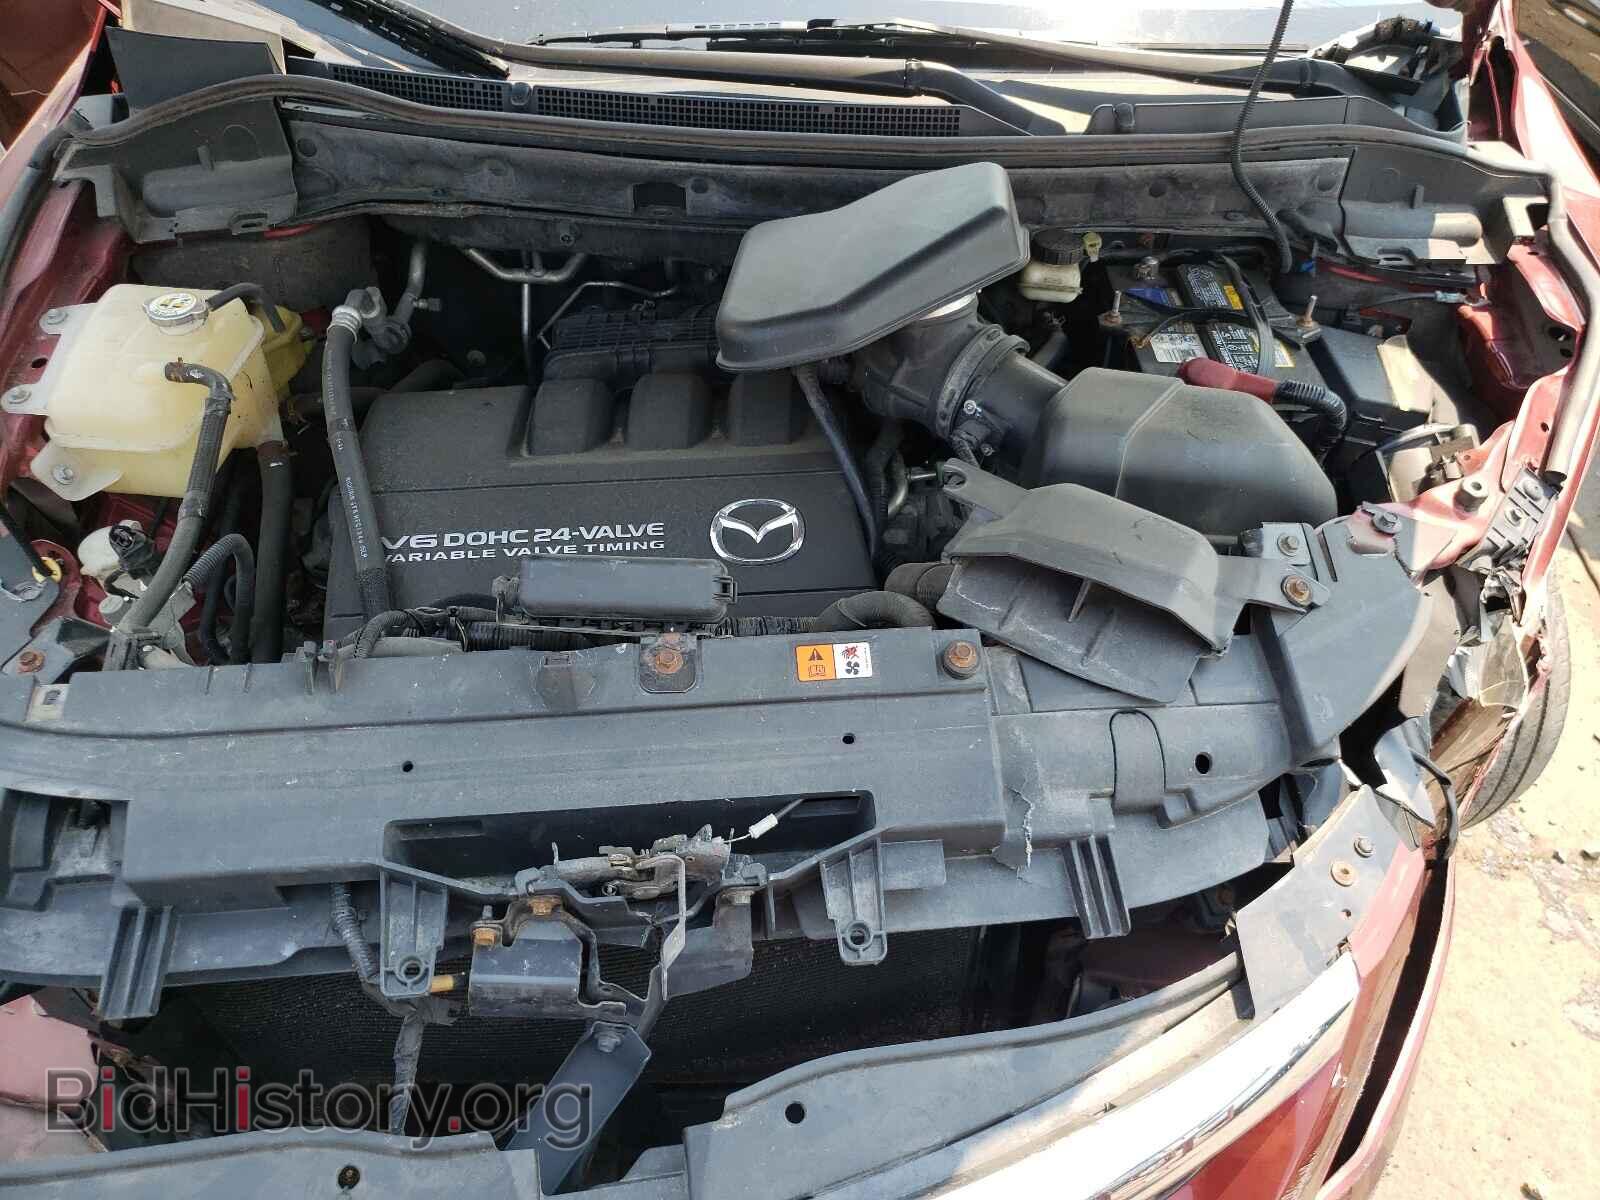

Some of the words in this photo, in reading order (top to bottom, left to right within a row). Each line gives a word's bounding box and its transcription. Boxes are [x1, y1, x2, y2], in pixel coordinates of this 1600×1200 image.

[381, 533, 438, 550] V6
[443, 529, 529, 547] DOHC
[533, 522, 665, 542] 24-VALVE
[503, 544, 578, 557] VALVE
[583, 540, 665, 553] TIMING
